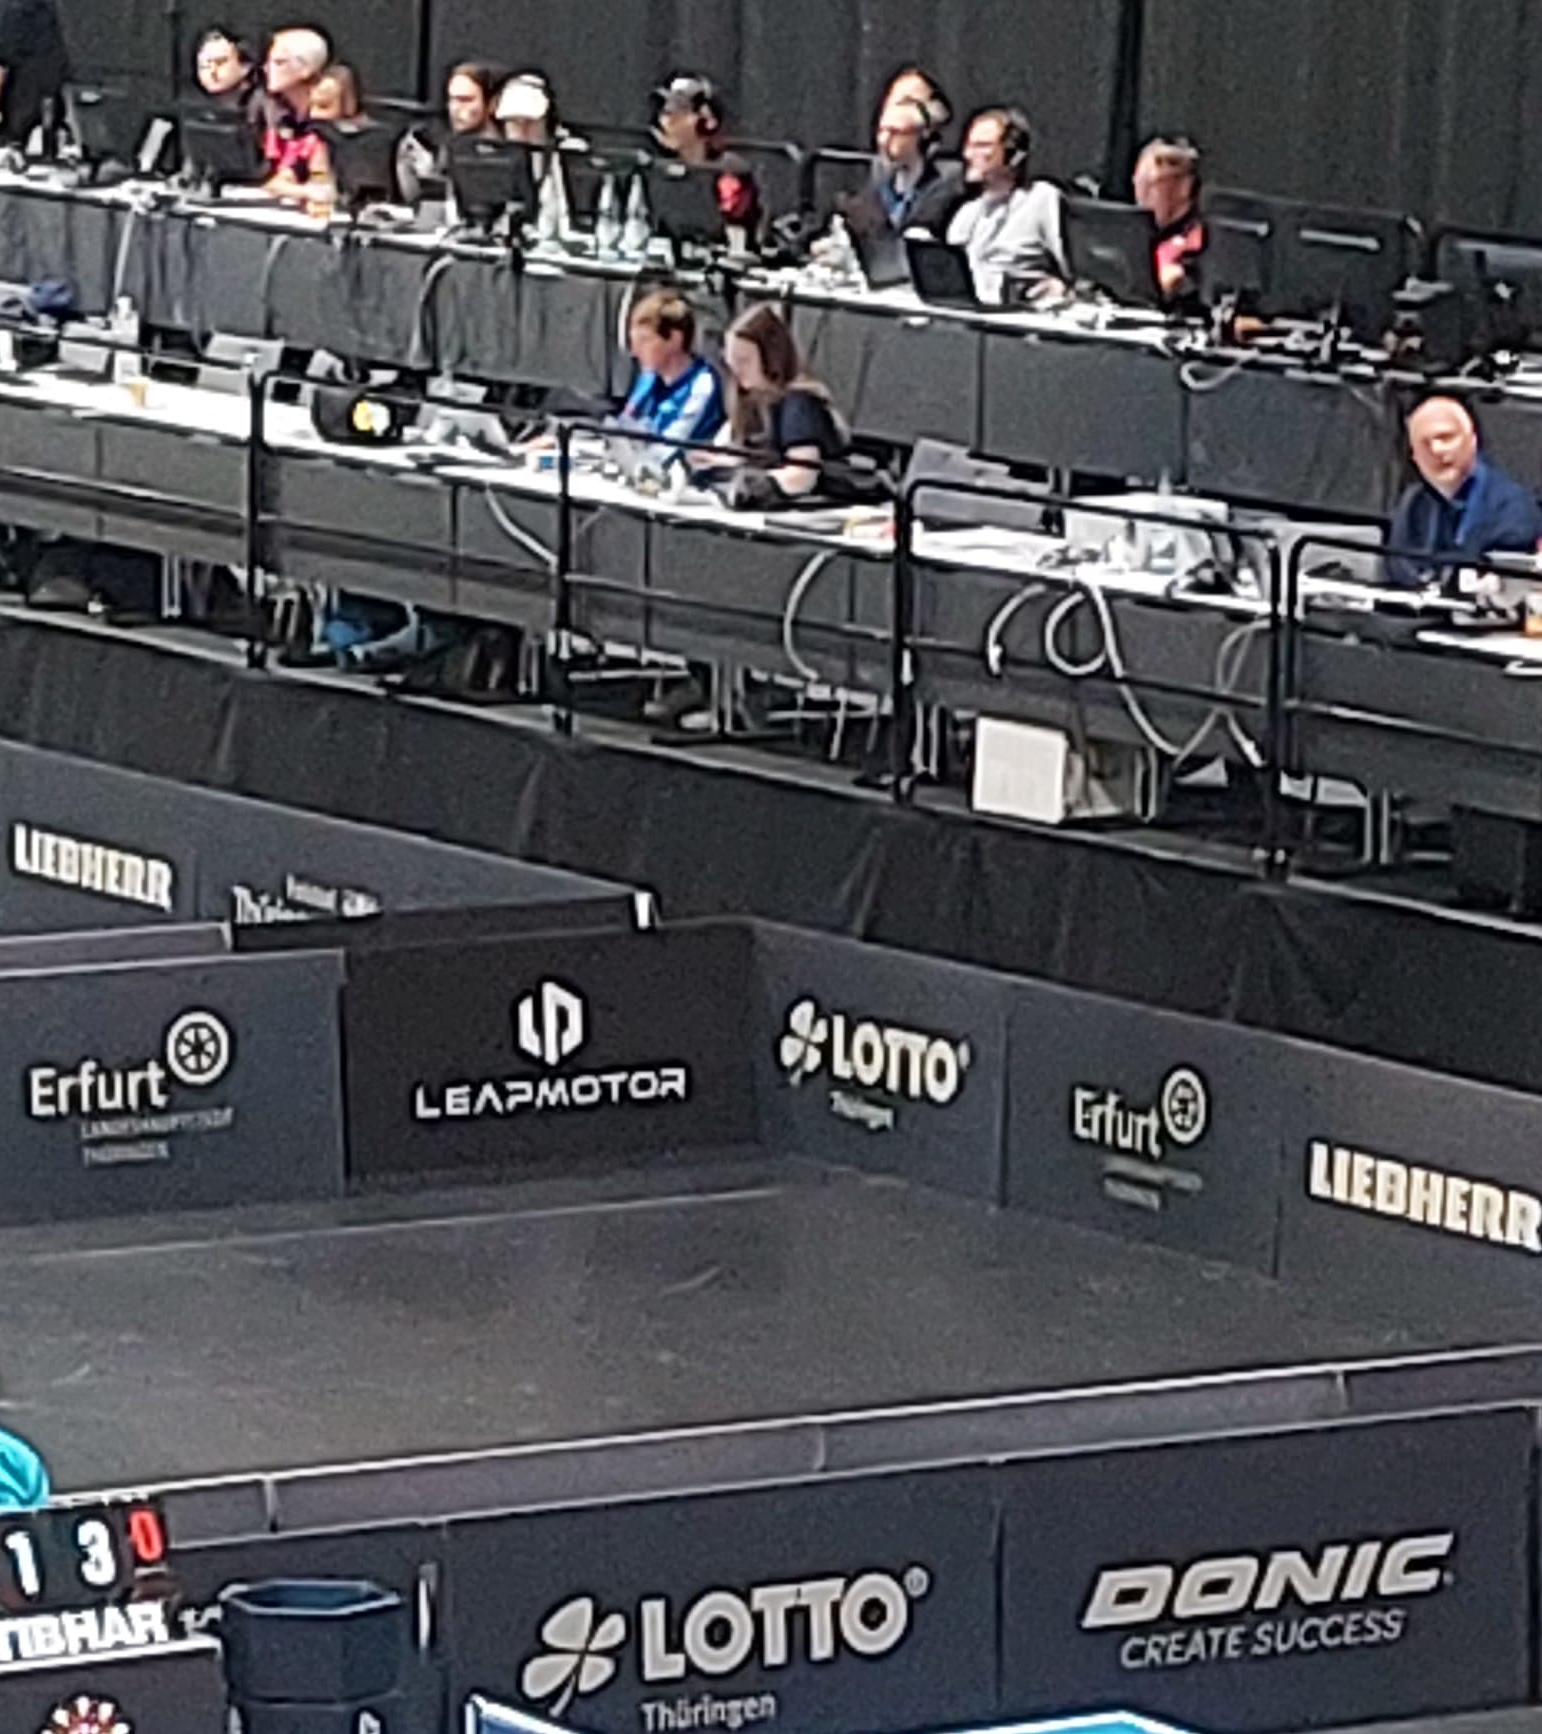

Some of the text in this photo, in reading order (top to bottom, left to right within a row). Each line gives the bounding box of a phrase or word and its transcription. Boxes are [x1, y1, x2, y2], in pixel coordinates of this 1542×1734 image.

[15, 823, 171, 913] LIEBHERR
[30, 1059, 168, 1116] Erfurt
[415, 1066, 687, 1120] LEAPMOTOR
[1073, 1086, 1161, 1157] Erfurt
[5, 1530, 40, 1596] 1
[77, 1520, 116, 1585] 3
[129, 1509, 163, 1562] 0
[1081, 1533, 1454, 1628] DONIC
[1120, 1609, 1406, 1668] CREATE SUCCESS
[640, 1694, 777, 1732] Thüringen
